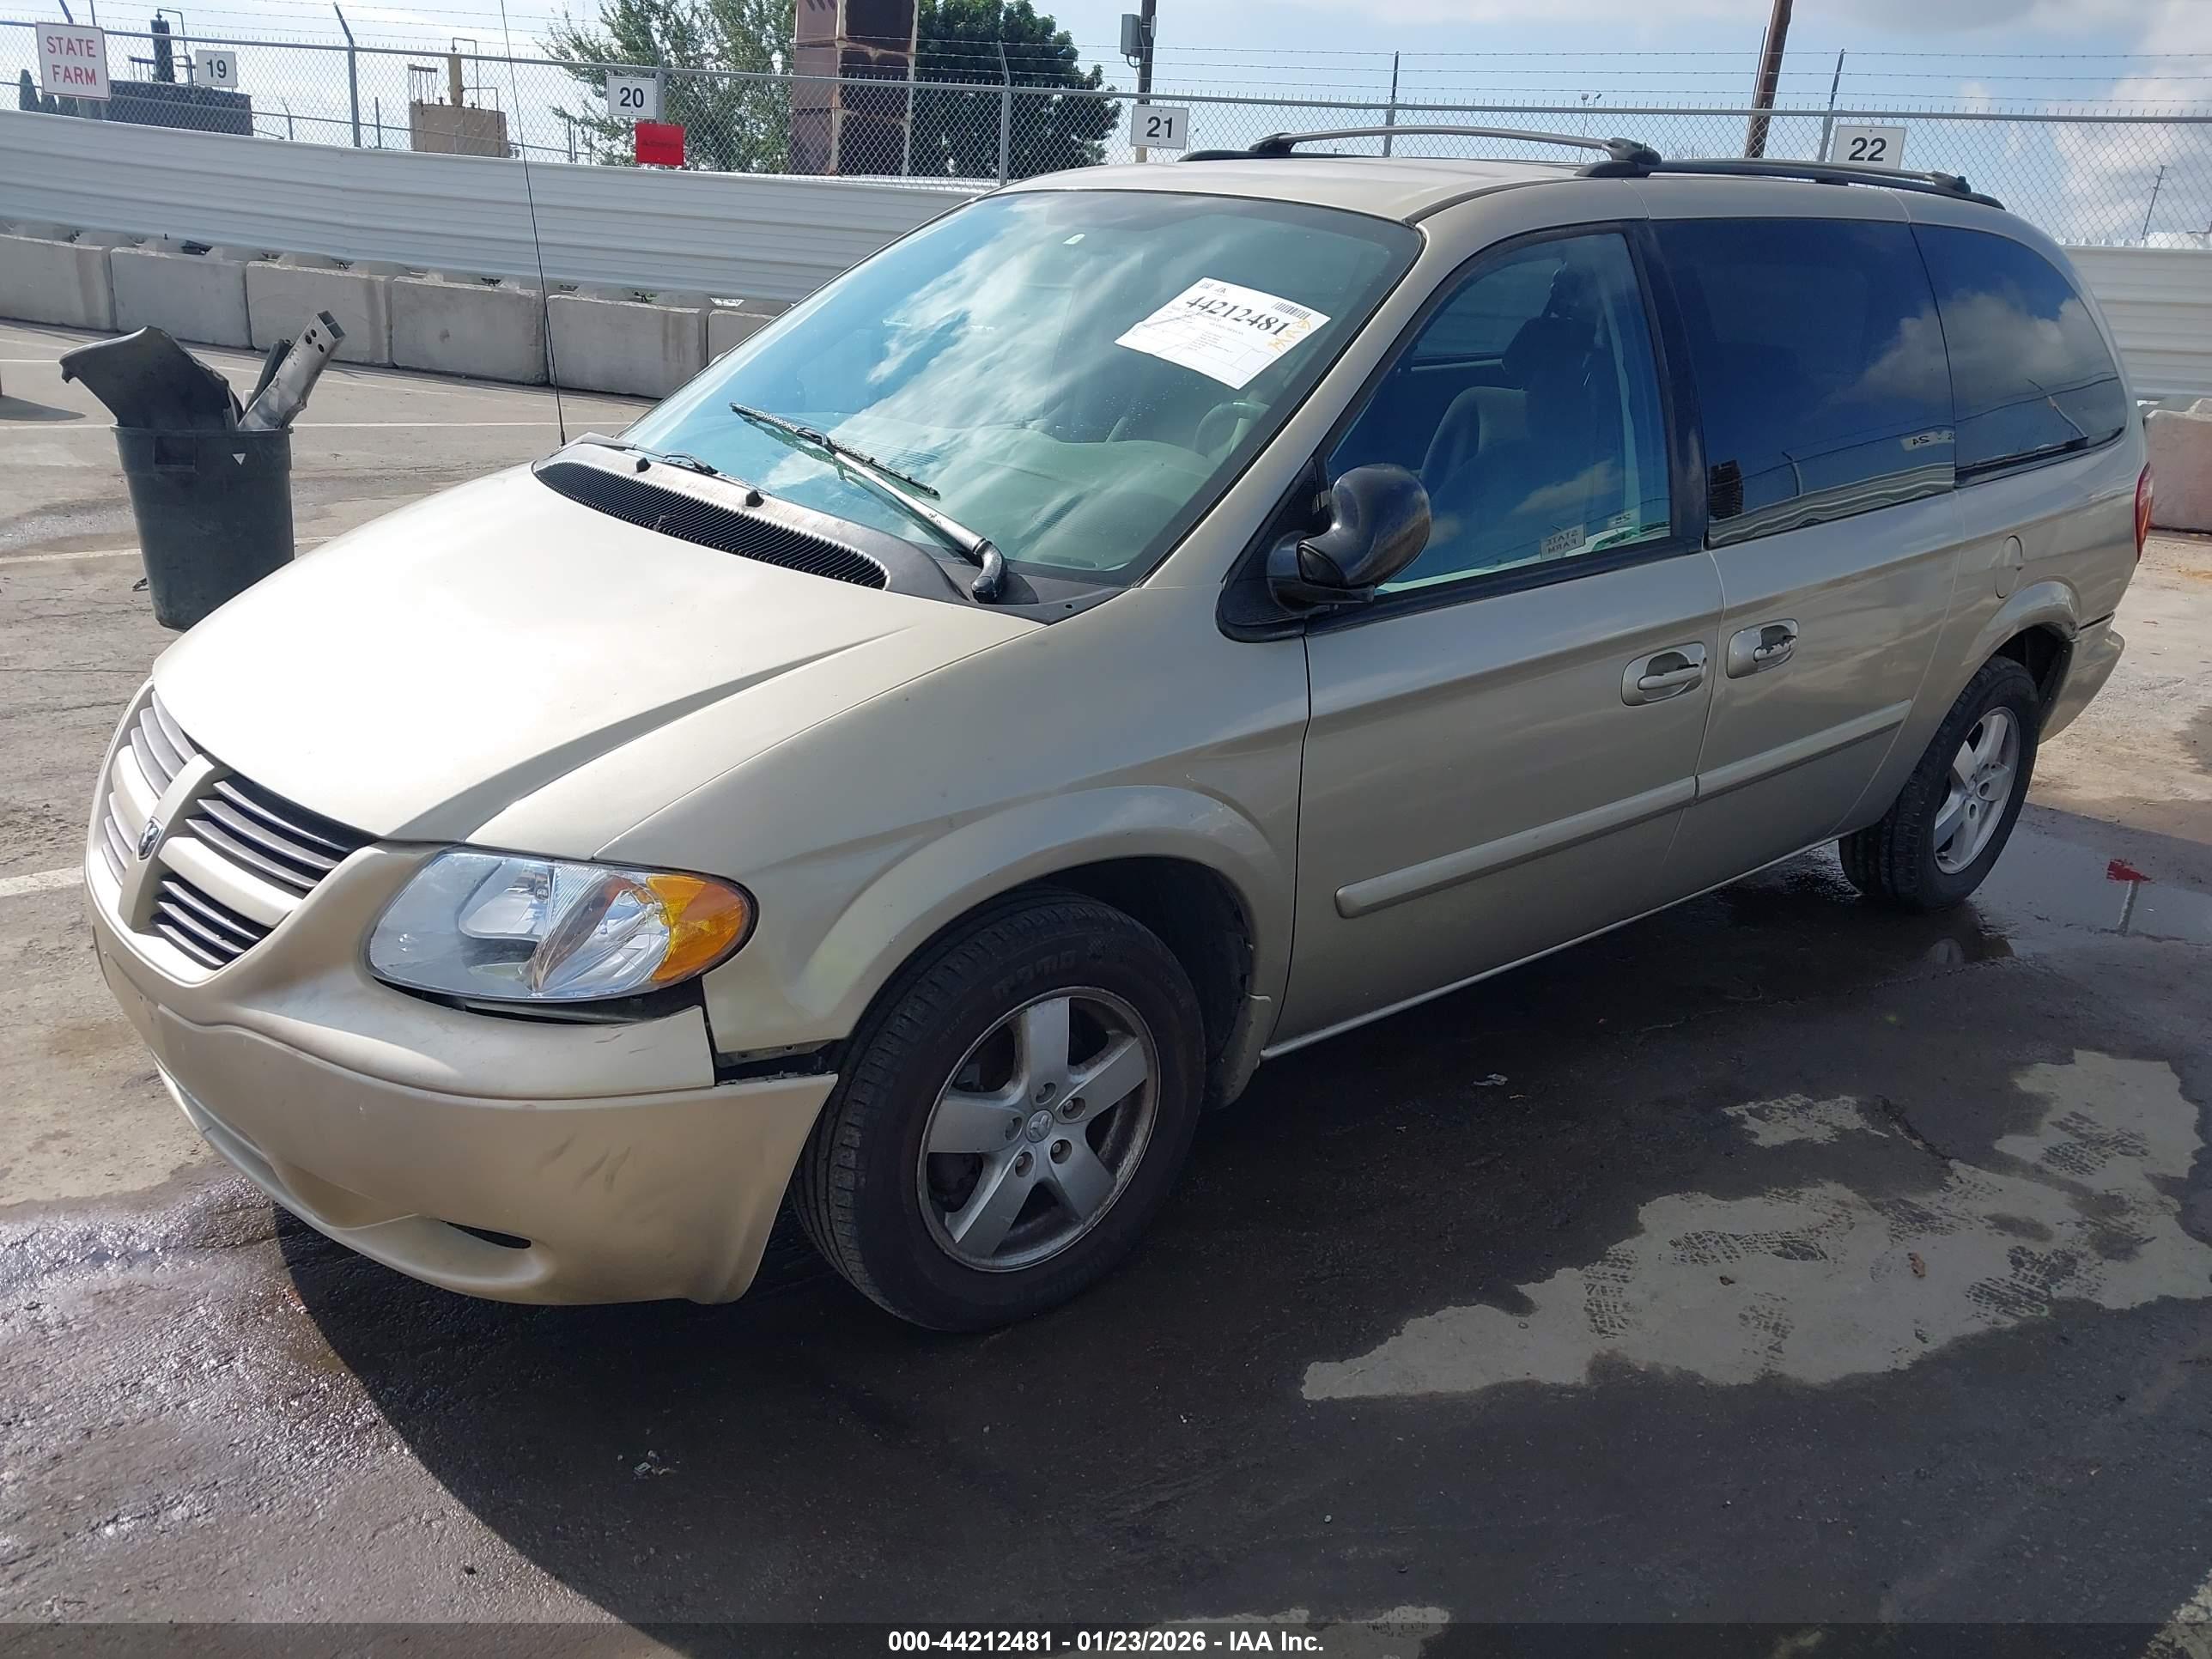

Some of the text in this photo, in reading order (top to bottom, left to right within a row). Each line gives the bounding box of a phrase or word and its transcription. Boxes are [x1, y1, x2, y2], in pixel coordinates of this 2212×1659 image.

[46, 36, 96, 58] STATE
[52, 64, 97, 86] FARM
[206, 59, 227, 79] 19
[619, 87, 644, 109] 20
[1146, 116, 1173, 138] 21
[1848, 137, 1887, 161] 22
[1186, 295, 1291, 336] 44212481
